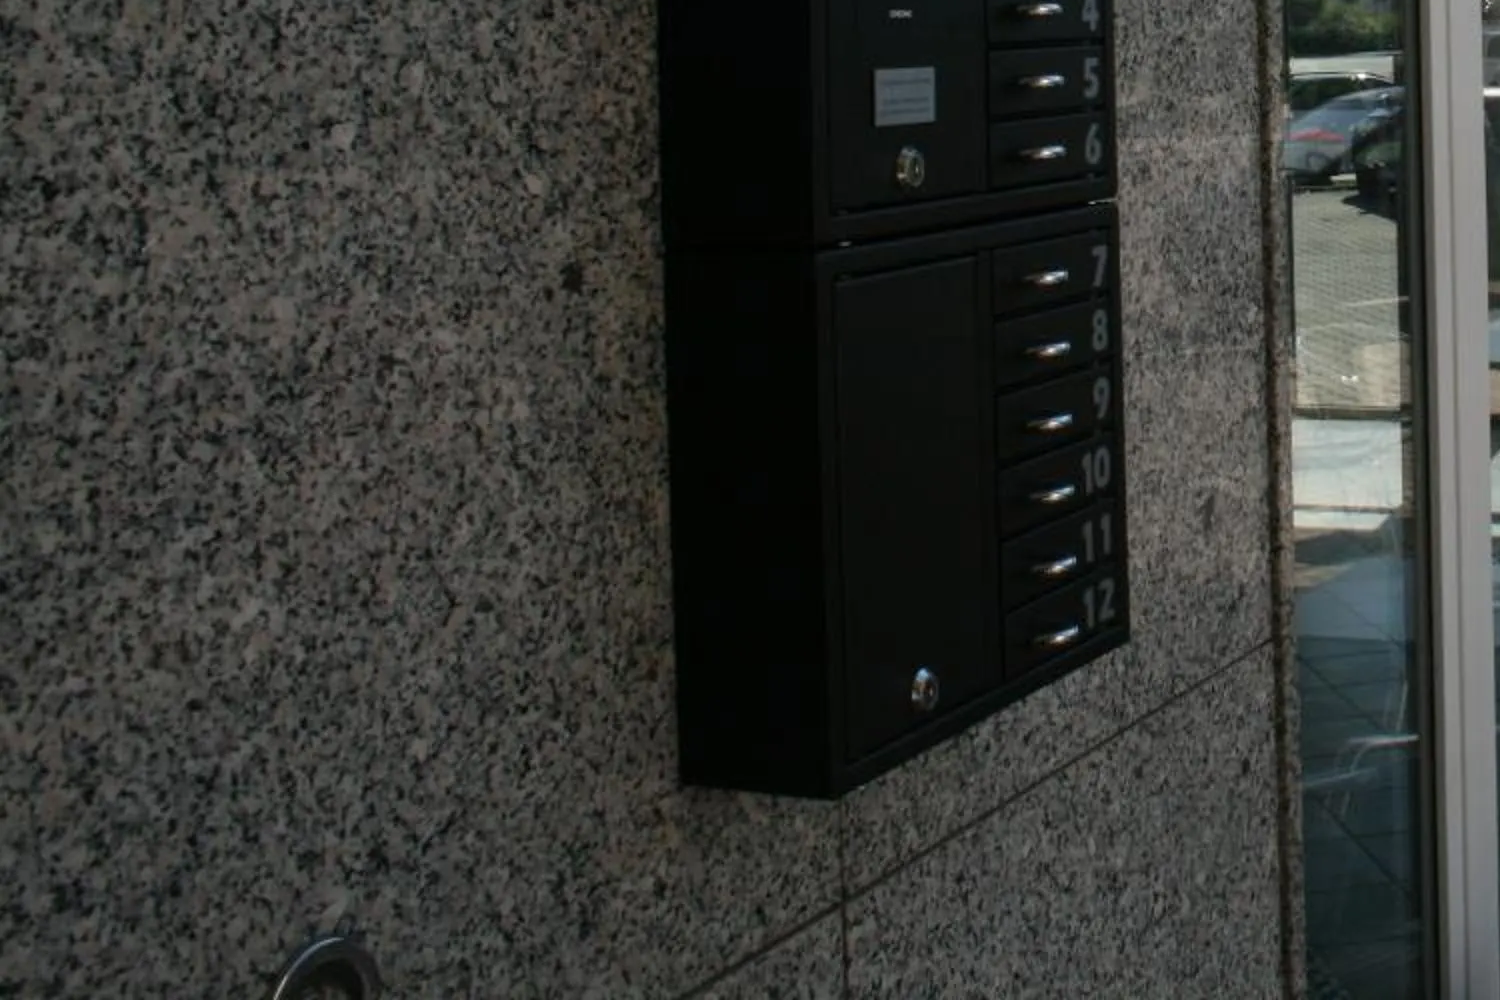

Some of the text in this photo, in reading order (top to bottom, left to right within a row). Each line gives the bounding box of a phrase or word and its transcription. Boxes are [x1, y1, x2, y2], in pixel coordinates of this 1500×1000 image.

[1082, 56, 1100, 100] 5
[1083, 122, 1102, 166] 6
[1091, 243, 1108, 288] 7
[1091, 308, 1109, 352] 8
[1092, 376, 1110, 420] 9
[1081, 446, 1111, 494] 10
[1082, 513, 1112, 563] 11
[1083, 577, 1115, 629] 12
